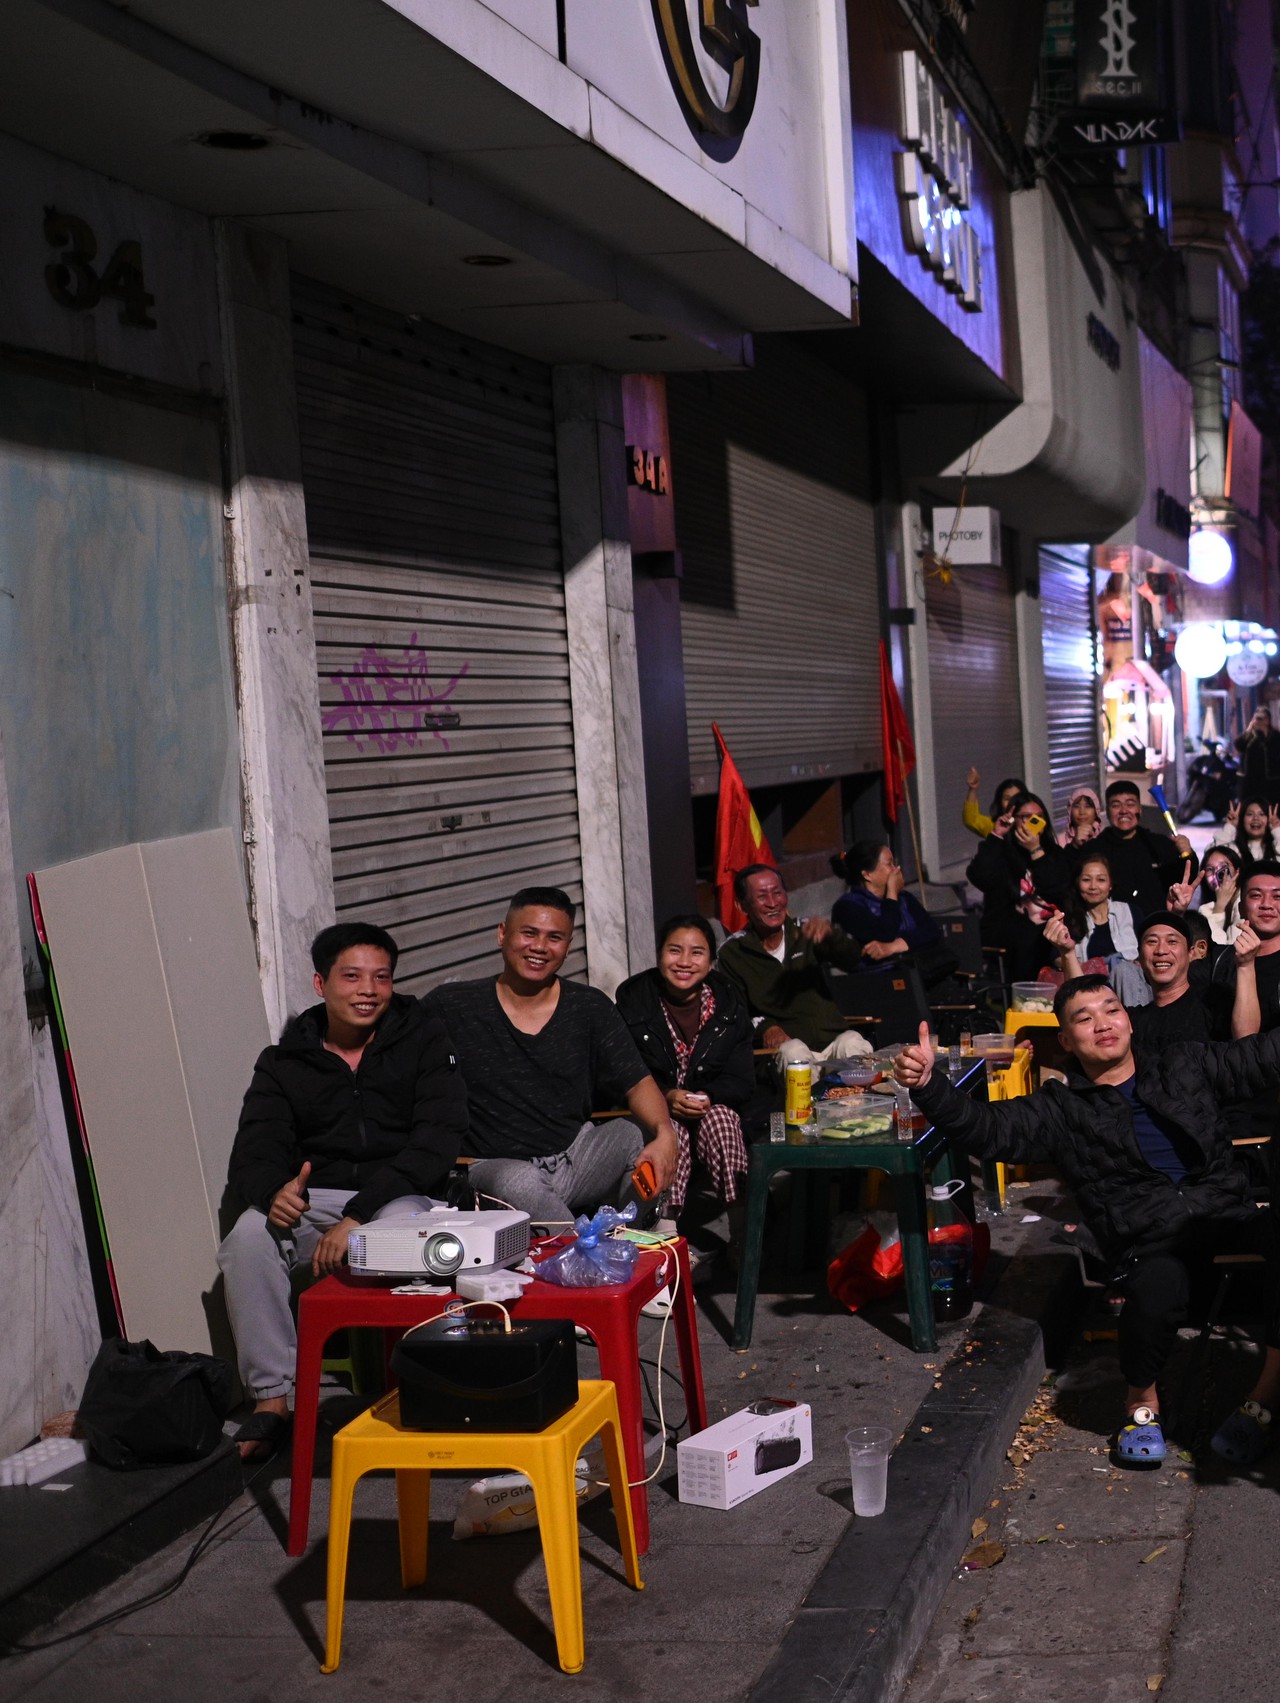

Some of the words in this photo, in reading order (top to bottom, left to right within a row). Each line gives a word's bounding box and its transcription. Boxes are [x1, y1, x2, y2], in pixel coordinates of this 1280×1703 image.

[44, 208, 157, 329] 34
[632, 446, 669, 495] 34A
[938, 530, 983, 542] PHOTOBY
[484, 1494, 508, 1506] TOP
